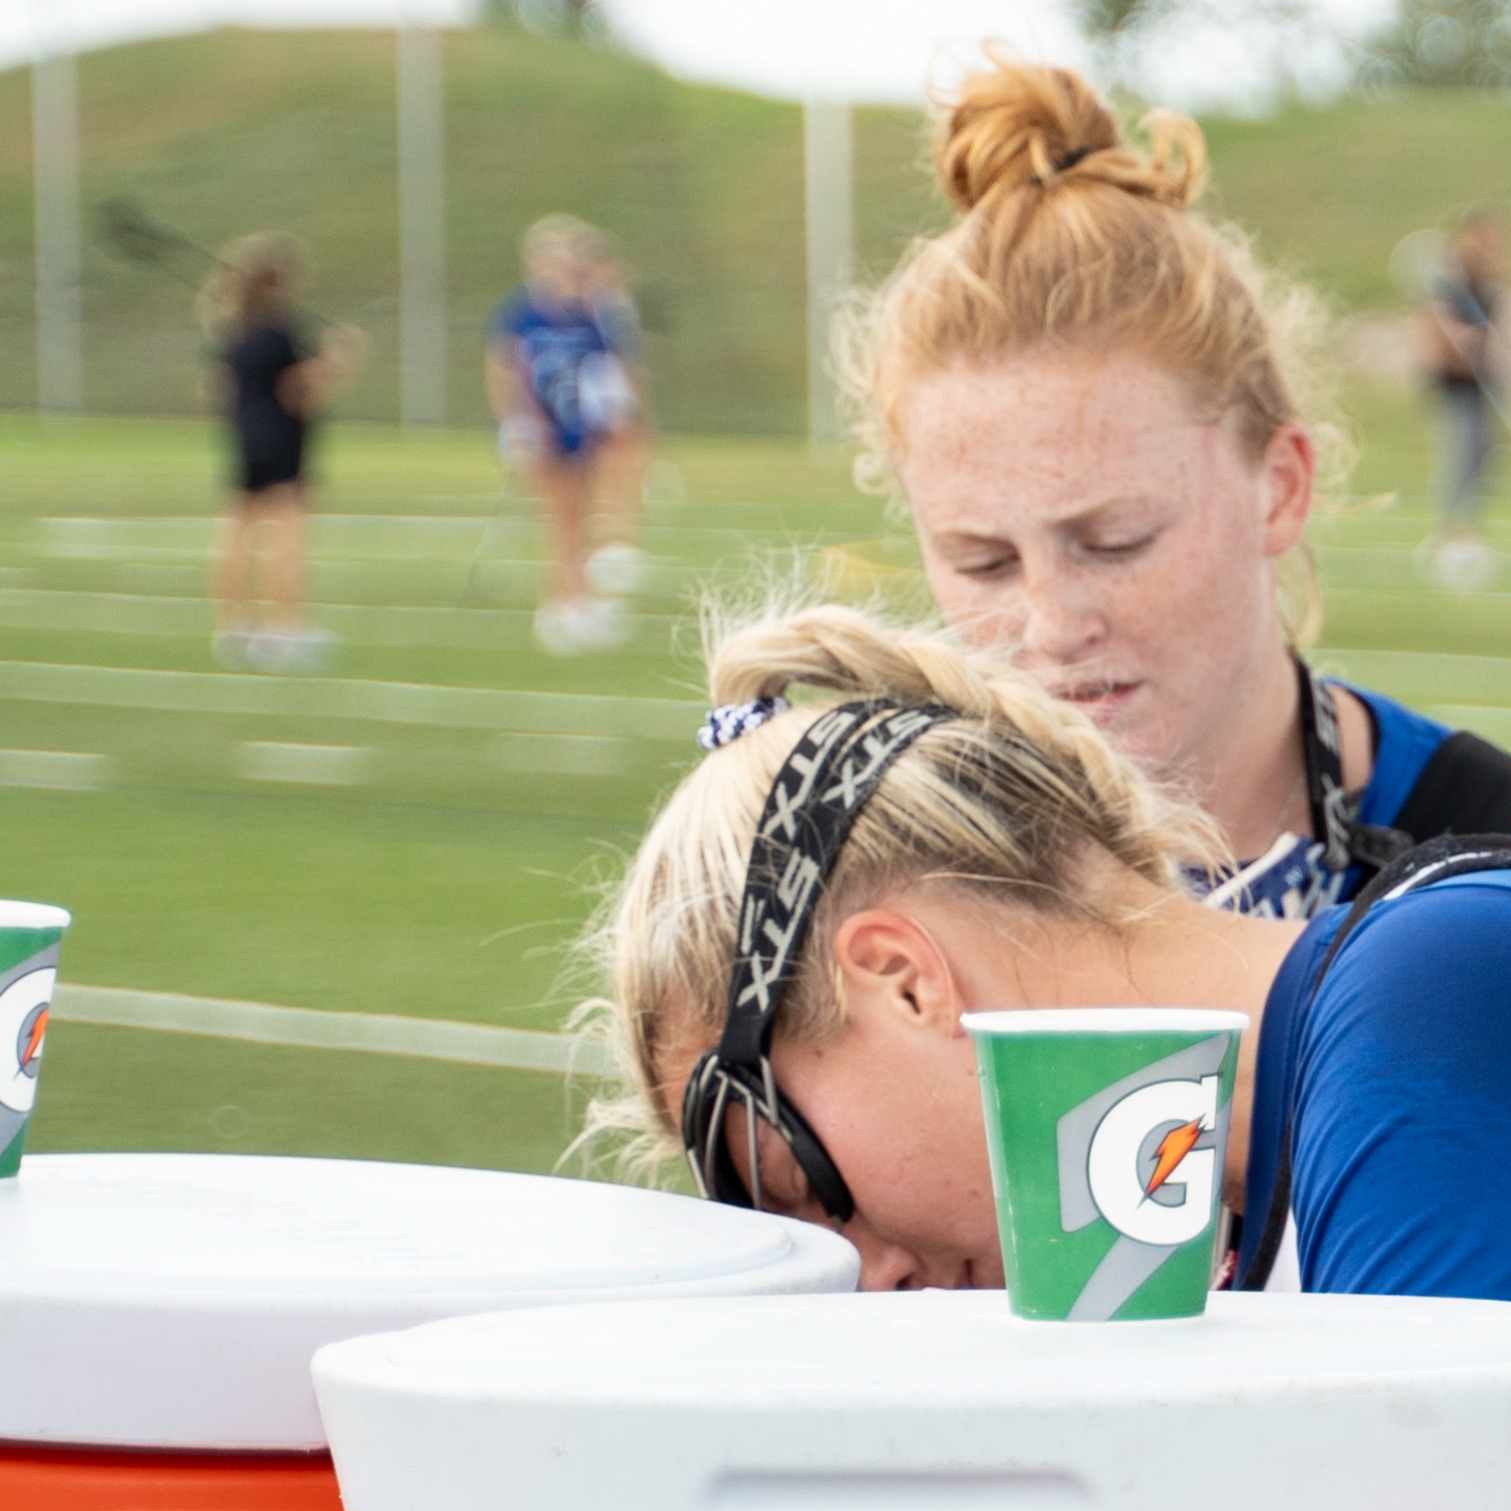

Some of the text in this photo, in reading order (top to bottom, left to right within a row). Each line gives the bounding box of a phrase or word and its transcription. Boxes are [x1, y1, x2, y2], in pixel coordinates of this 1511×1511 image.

[762, 710, 857, 842] STX
[821, 709, 933, 810] STX
[735, 846, 821, 1013] STX
[1086, 1073, 1220, 1246] G
